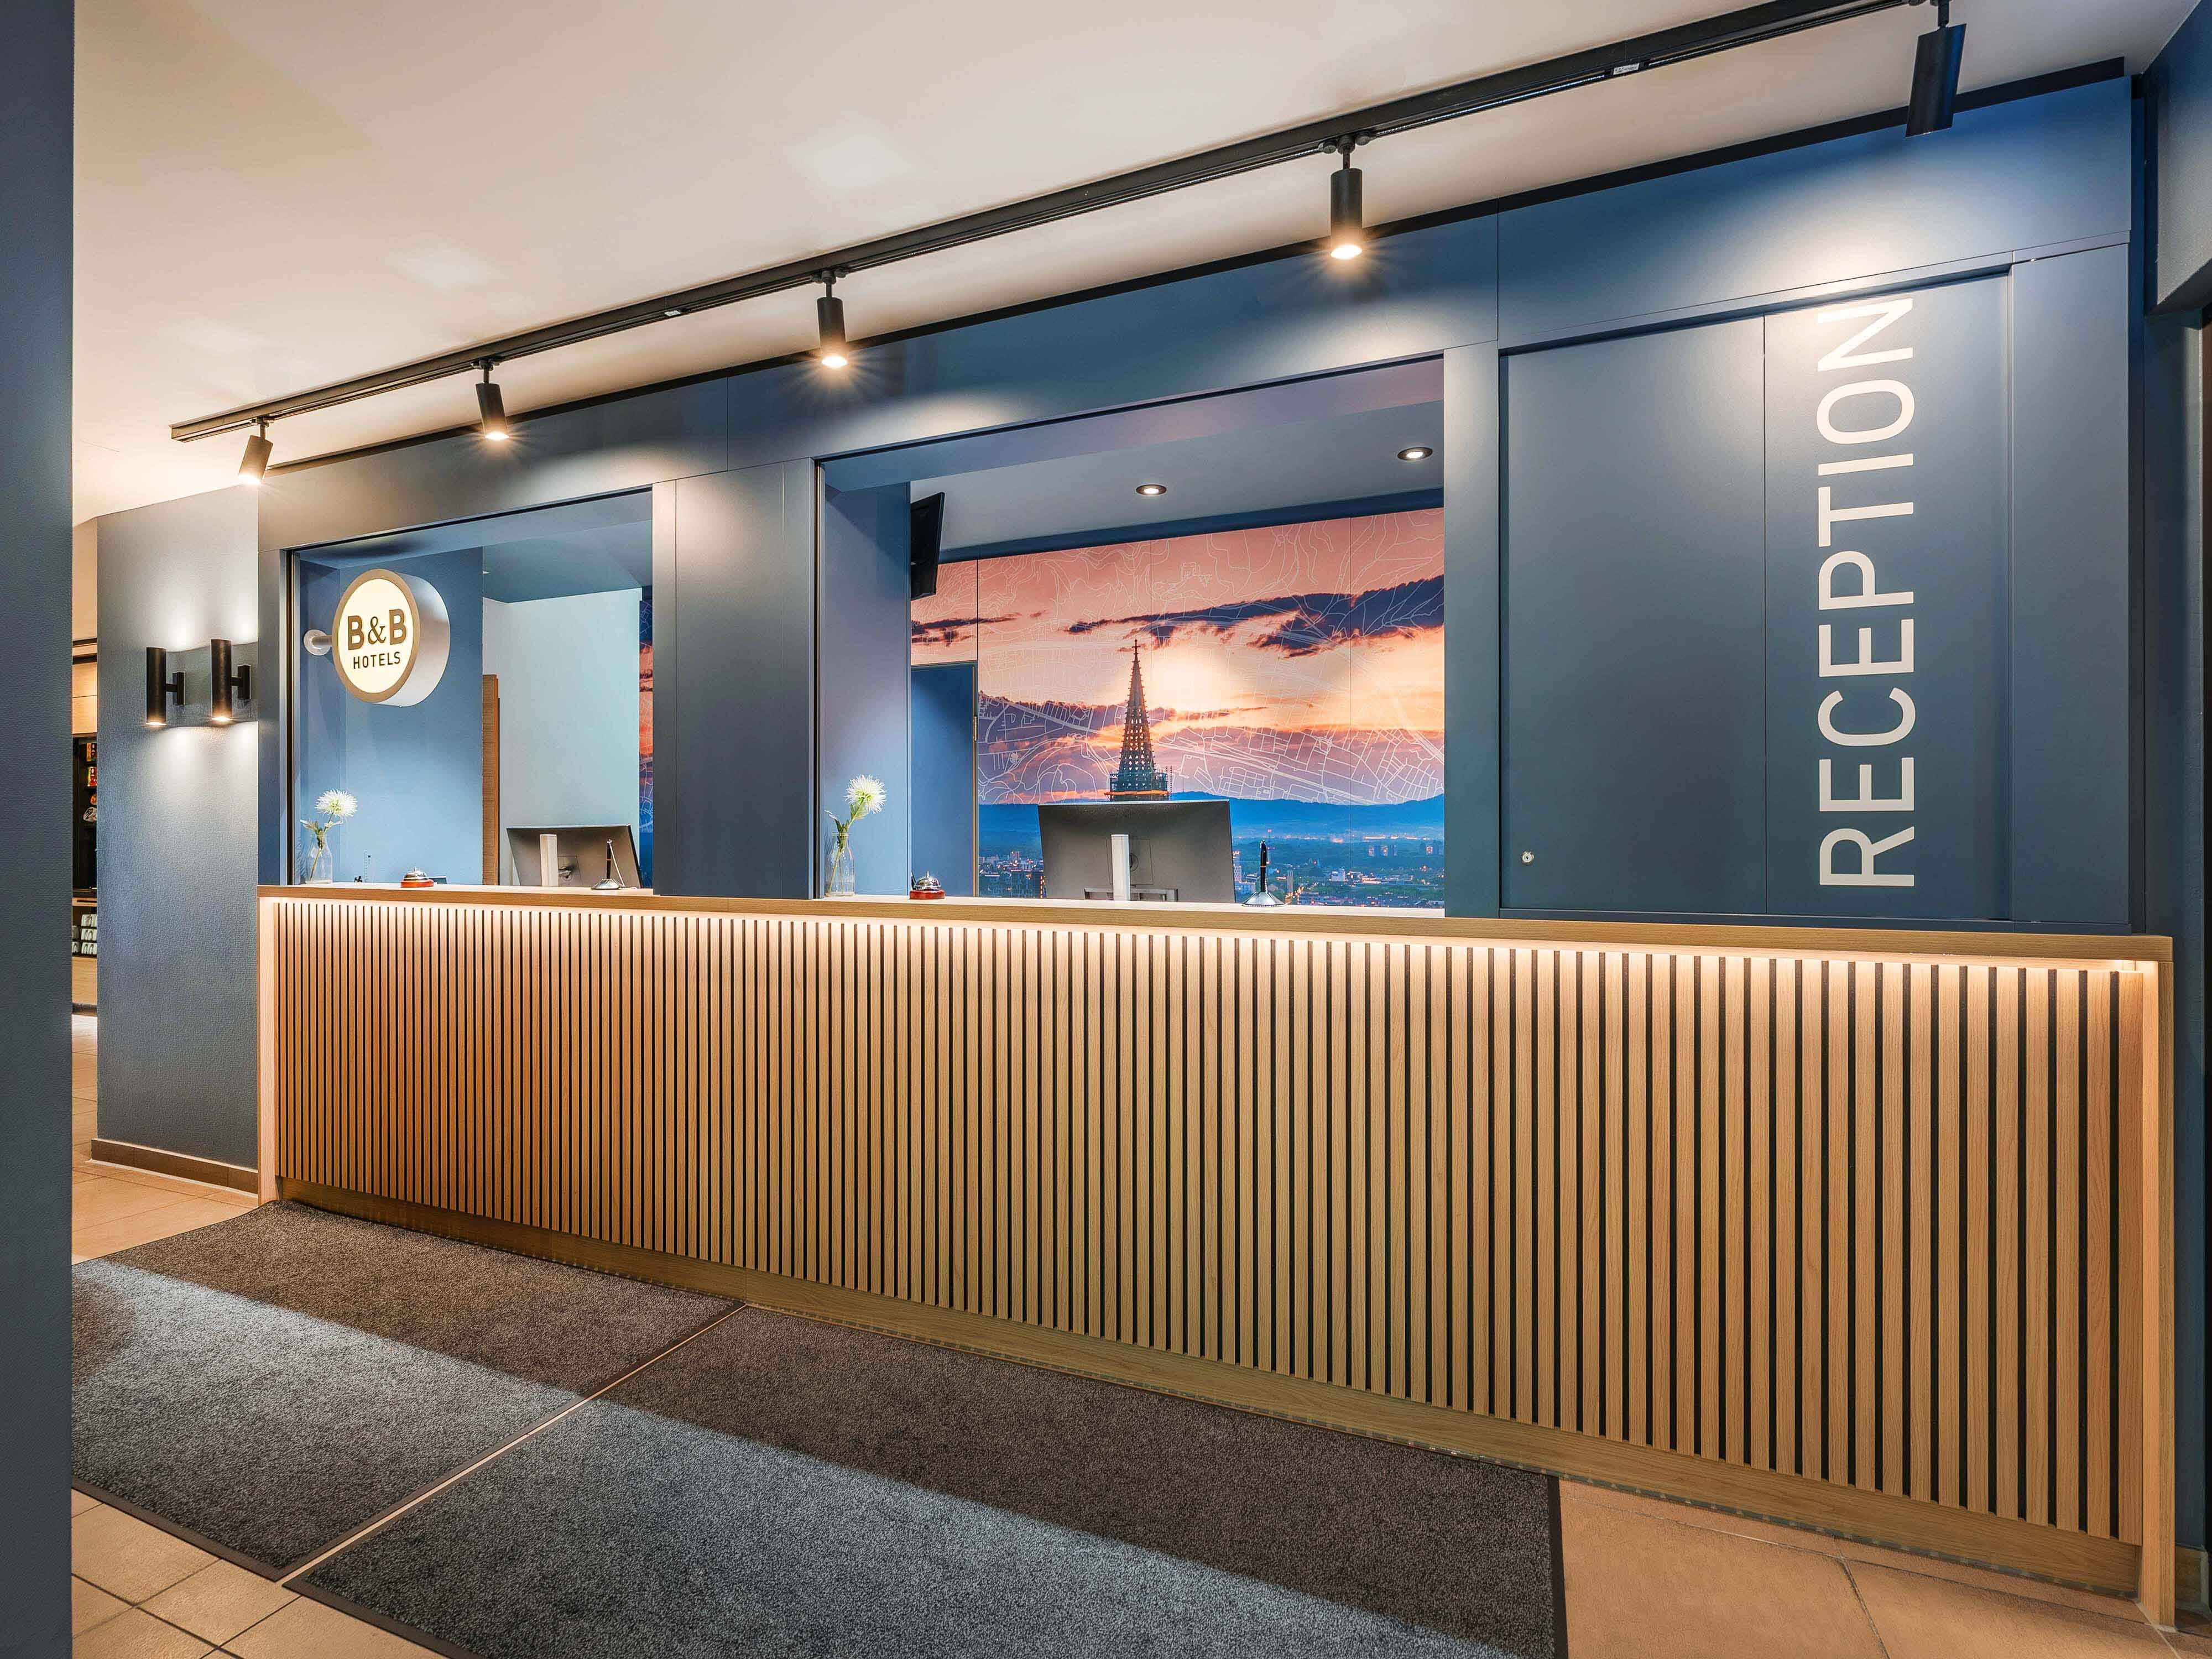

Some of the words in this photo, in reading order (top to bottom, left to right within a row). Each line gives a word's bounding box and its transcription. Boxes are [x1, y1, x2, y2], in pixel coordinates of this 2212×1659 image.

[1817, 298, 1916, 886] RECEPTION
[347, 608, 407, 651] B&B
[353, 651, 401, 670] HOTELS
